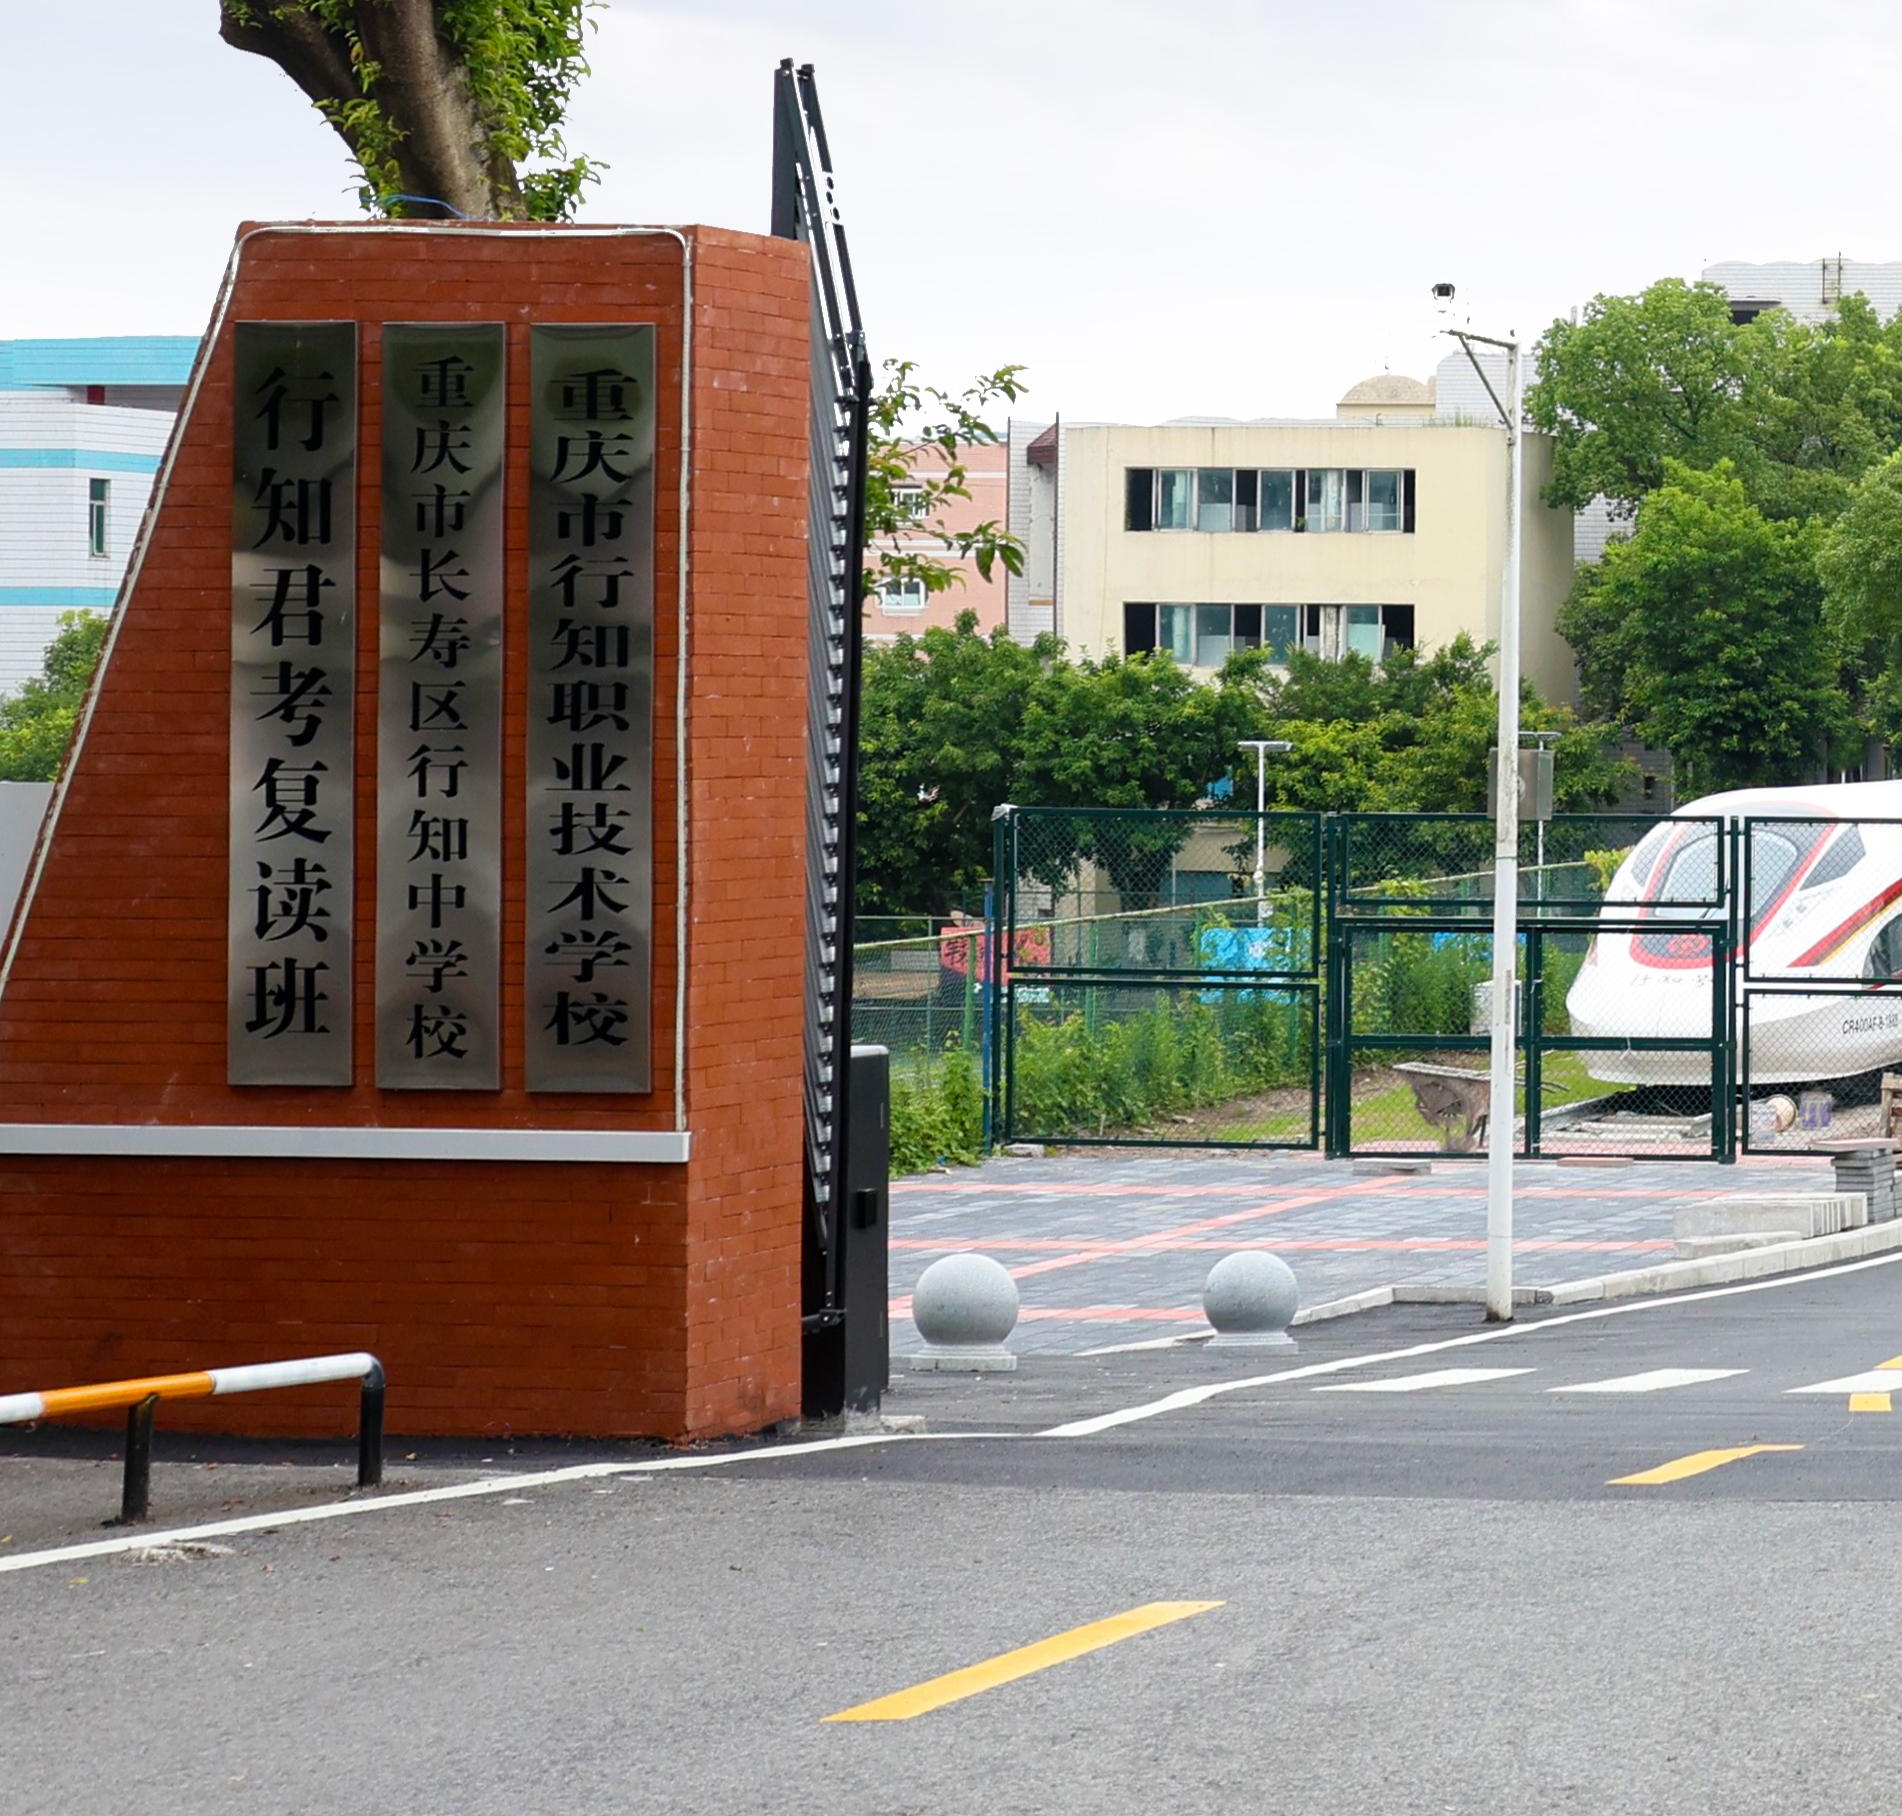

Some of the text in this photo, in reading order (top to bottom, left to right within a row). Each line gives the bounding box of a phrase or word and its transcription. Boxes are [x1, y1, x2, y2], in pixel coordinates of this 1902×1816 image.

[245, 366, 341, 1040] 行知君考复读班
[405, 355, 475, 1060] 重庆市长寿区行知中学校
[543, 368, 638, 1048] 重庆市行知职业技术学校
